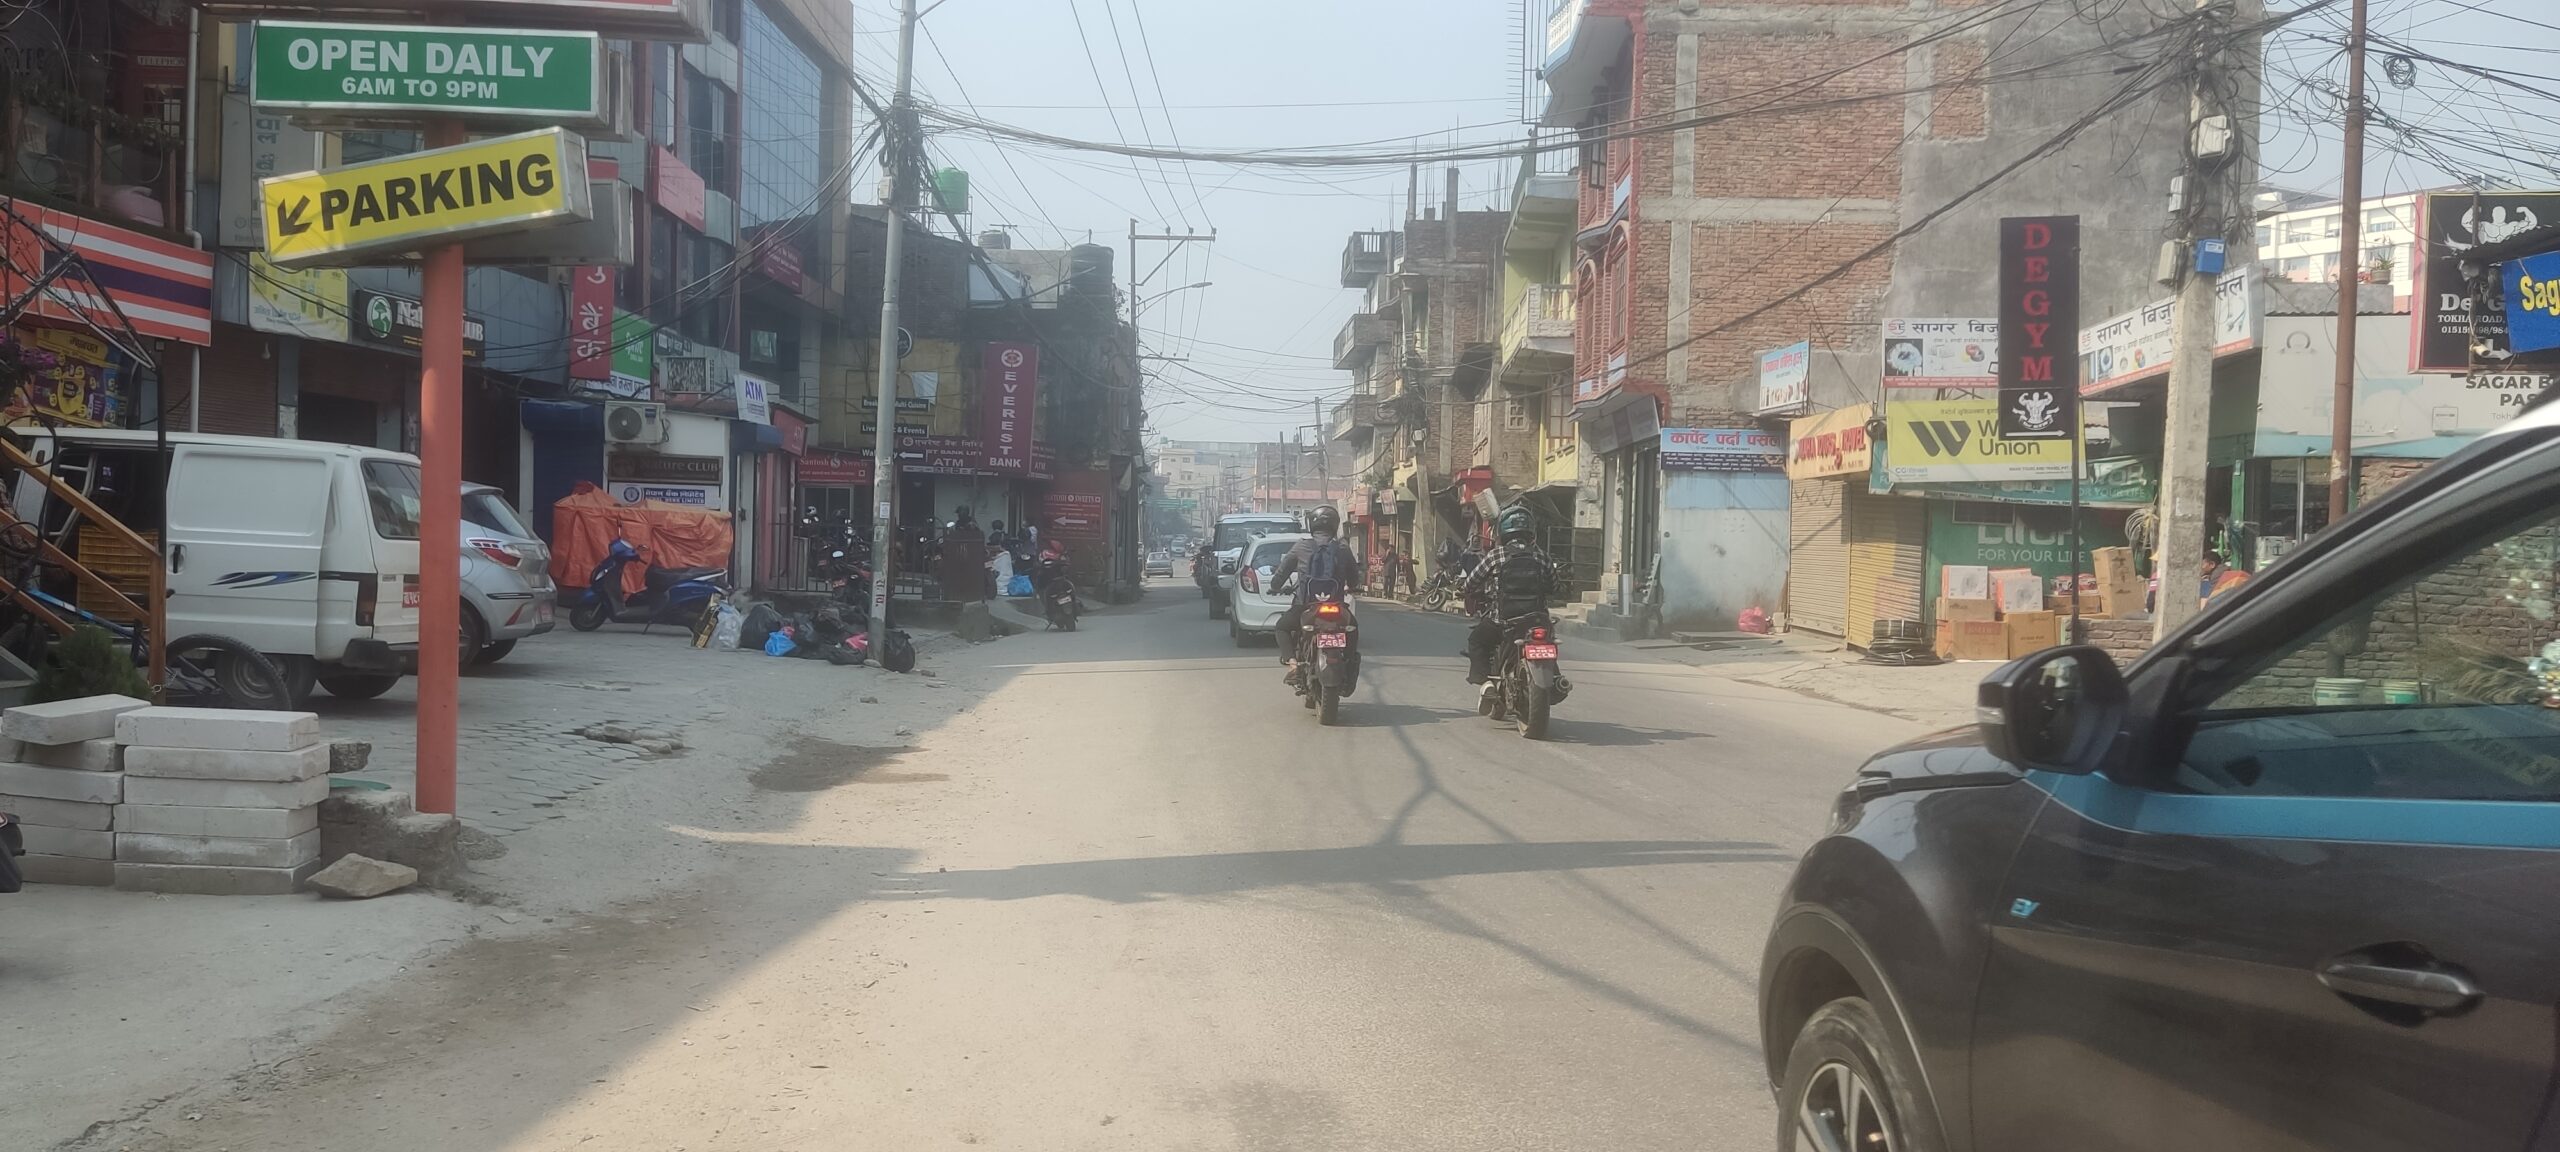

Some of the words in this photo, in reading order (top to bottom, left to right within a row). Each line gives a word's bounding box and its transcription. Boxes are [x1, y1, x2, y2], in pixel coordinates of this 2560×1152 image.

[288, 38, 408, 73] OPEN
[425, 42, 554, 78] DAILY
[341, 77, 395, 96] 6AM
[404, 79, 437, 97] TO
[446, 81, 498, 99] 9PM
[320, 153, 554, 231] PARKING
[2020, 223, 2054, 382] DEGYM
[1912, 323, 1958, 335] सागर
[2466, 375, 2532, 389] SAGAR
[745, 380, 764, 402] ATM
[1000, 371, 1017, 455] EVEREST
[862, 424, 876, 433] Live
[904, 426, 926, 434] Events
[1979, 438, 2041, 456] Union
[687, 462, 718, 472] CLUB
[933, 459, 964, 468] ATM
[989, 457, 1022, 469] BANK
[1978, 548, 2006, 561] FOR
[2010, 549, 2054, 562] YOUR
